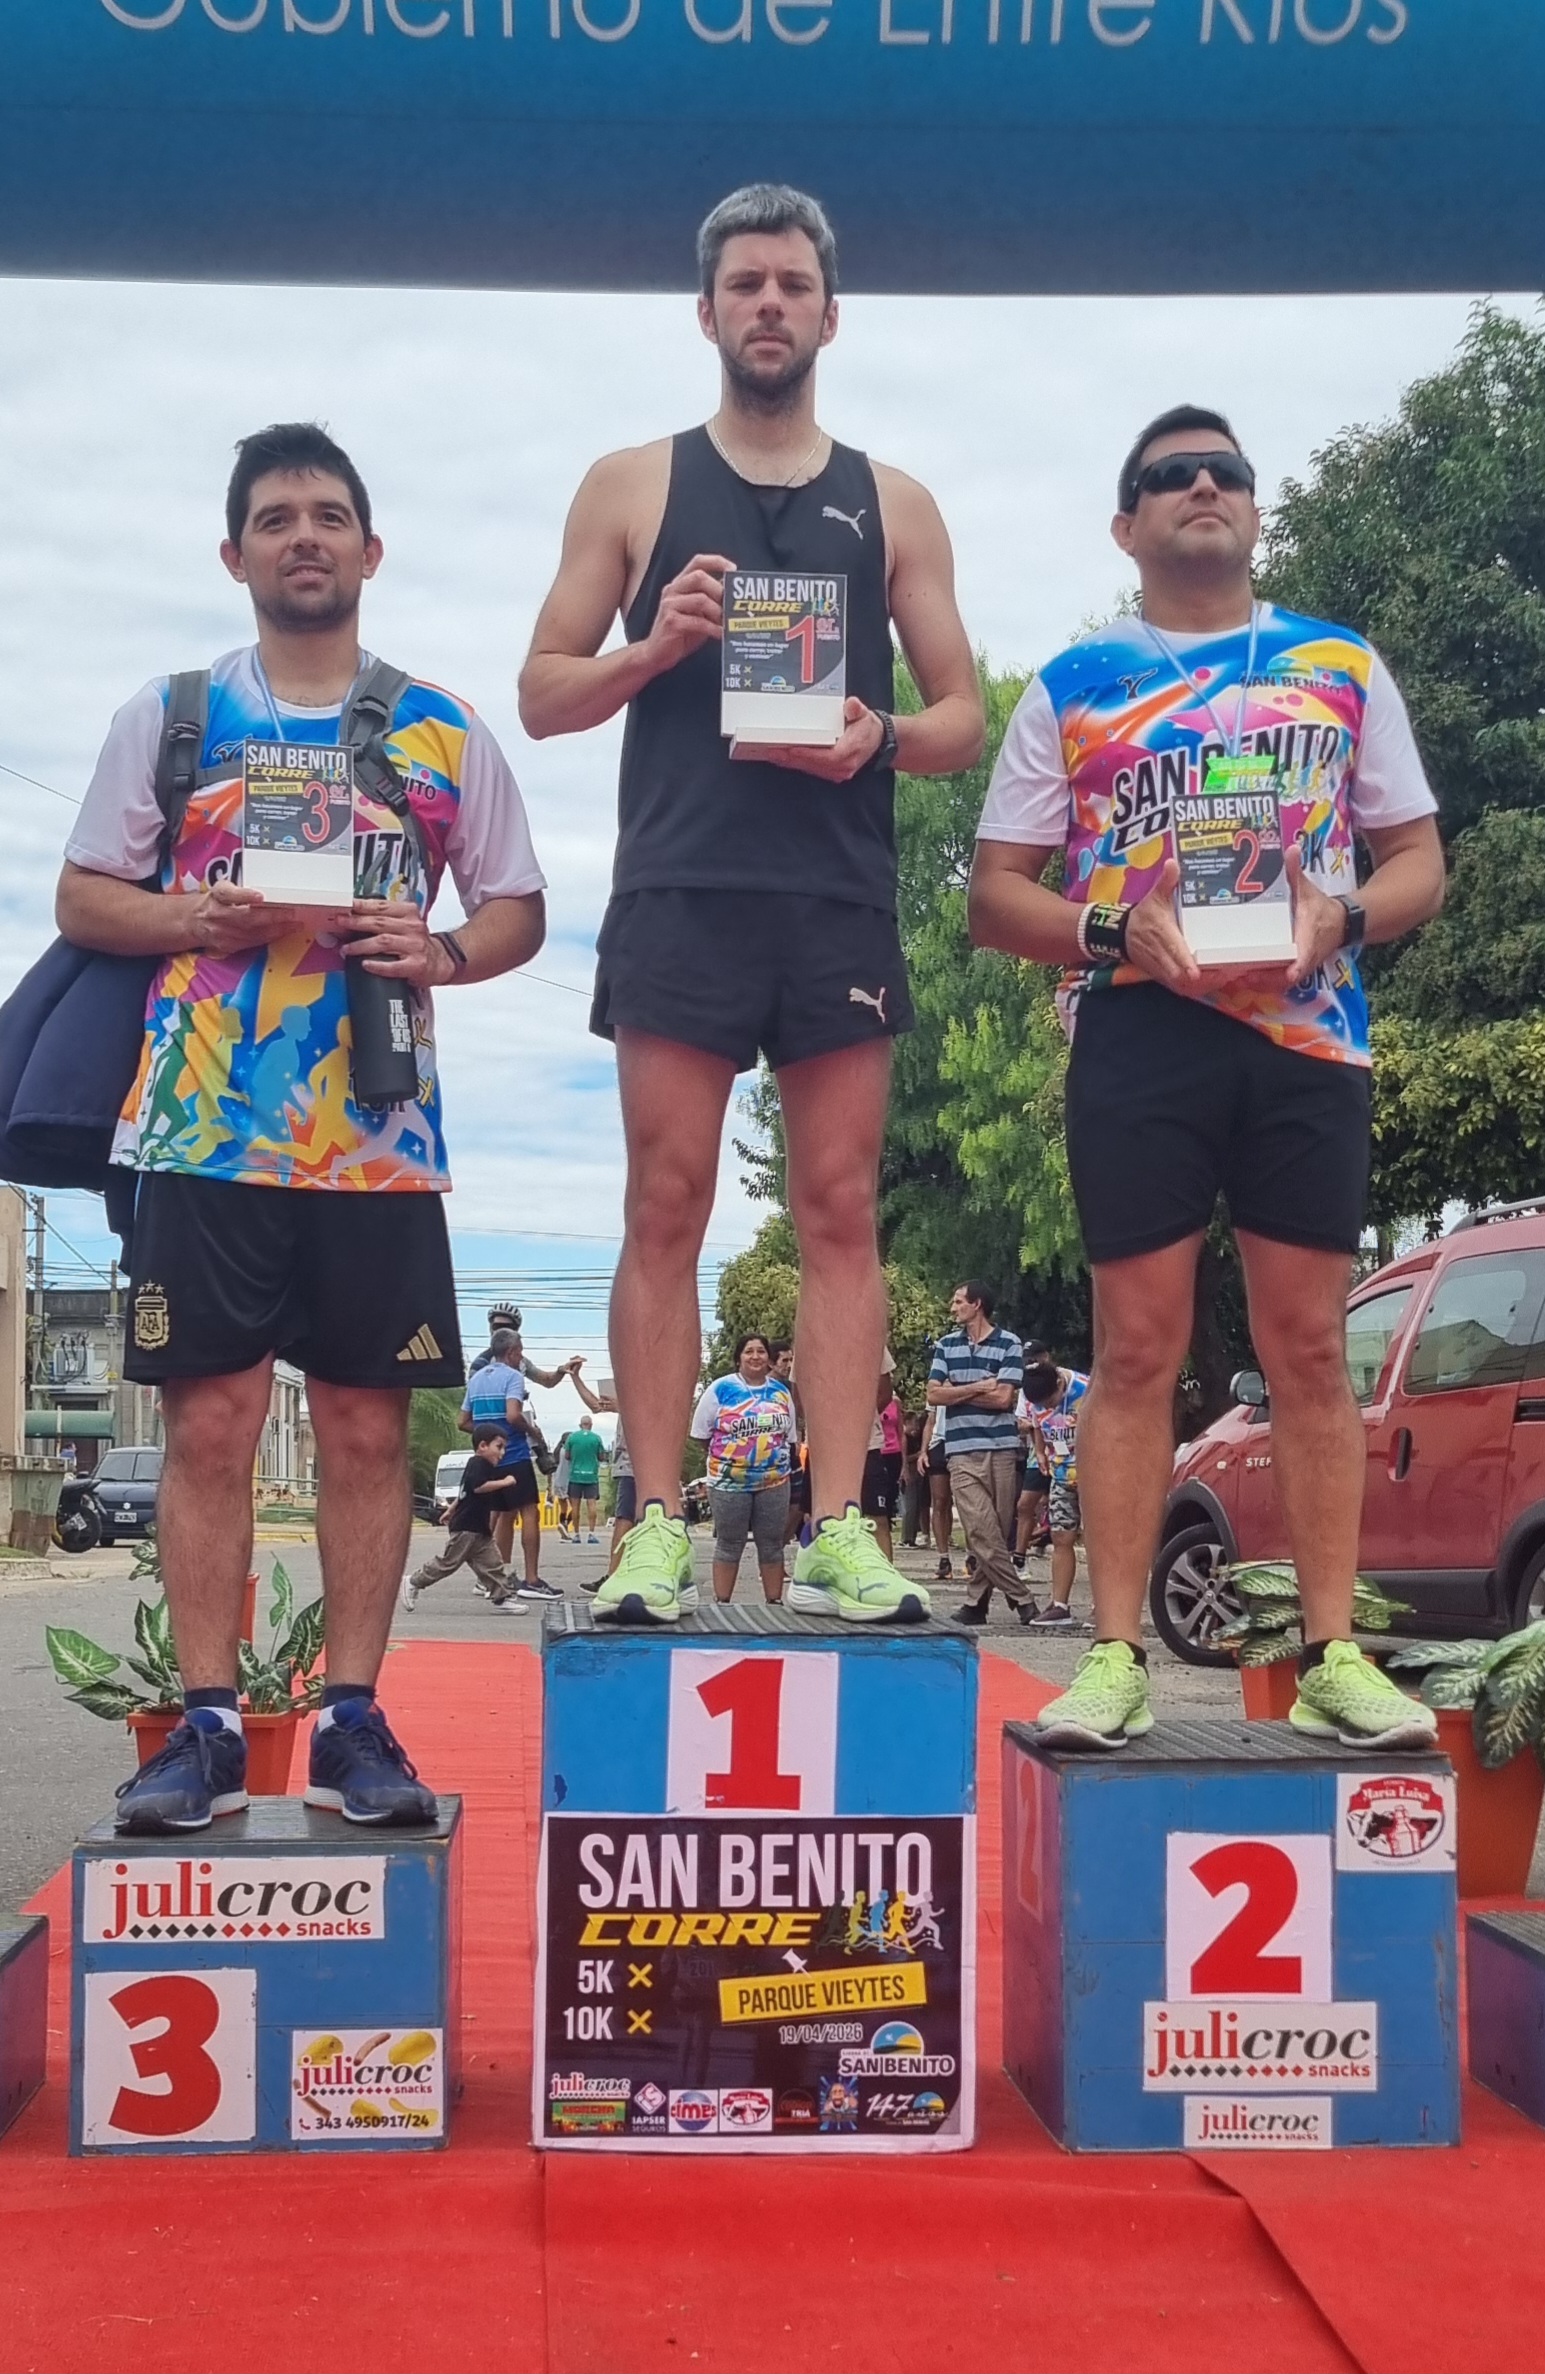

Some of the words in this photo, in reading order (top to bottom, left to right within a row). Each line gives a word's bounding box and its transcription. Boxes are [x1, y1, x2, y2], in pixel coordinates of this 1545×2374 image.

[733, 577, 768, 600] SAN
[774, 579, 838, 603] BENITO
[733, 600, 804, 613] CORRE
[785, 615, 814, 684] 1
[726, 677, 741, 688] 10K
[247, 745, 281, 767] SAN
[286, 748, 347, 771] BENITO
[248, 766, 316, 779] CORRE
[1112, 749, 1187, 826] SAN
[1201, 724, 1340, 793] BNITO
[302, 781, 331, 844] 3
[1175, 799, 1210, 822] SAN
[1214, 795, 1274, 819] BENITO
[1178, 819, 1244, 832] CORRE
[1233, 829, 1263, 893] 2
[732, 1417, 755, 1433] SAN
[696, 1658, 801, 1809] 1
[579, 1834, 698, 1908] SAN
[719, 1832, 932, 1908] BENITO
[103, 1861, 371, 1939] julicroc
[296, 1918, 371, 1936] snacks
[578, 1913, 821, 1946] CORRE
[1189, 1841, 1302, 1994] 2
[577, 1960, 613, 1994] 5K
[738, 1981, 816, 2014] PARQUE
[821, 1975, 905, 2007] VIEYTES
[563, 2006, 613, 2041] 10K
[779, 2023, 864, 2044] 19/04/2026
[108, 1975, 221, 2136] 3
[1147, 2011, 1371, 2077] julicroc
[297, 2056, 433, 2096] julicroc
[840, 2057, 878, 2074] SAN
[884, 2057, 954, 2074] BENITO
[1308, 2062, 1371, 2077] snacks
[394, 2084, 433, 2094] snacks
[316, 2117, 342, 2129] 343
[346, 2113, 429, 2129] 4950917/24
[1198, 2104, 1319, 2140] julicroc
